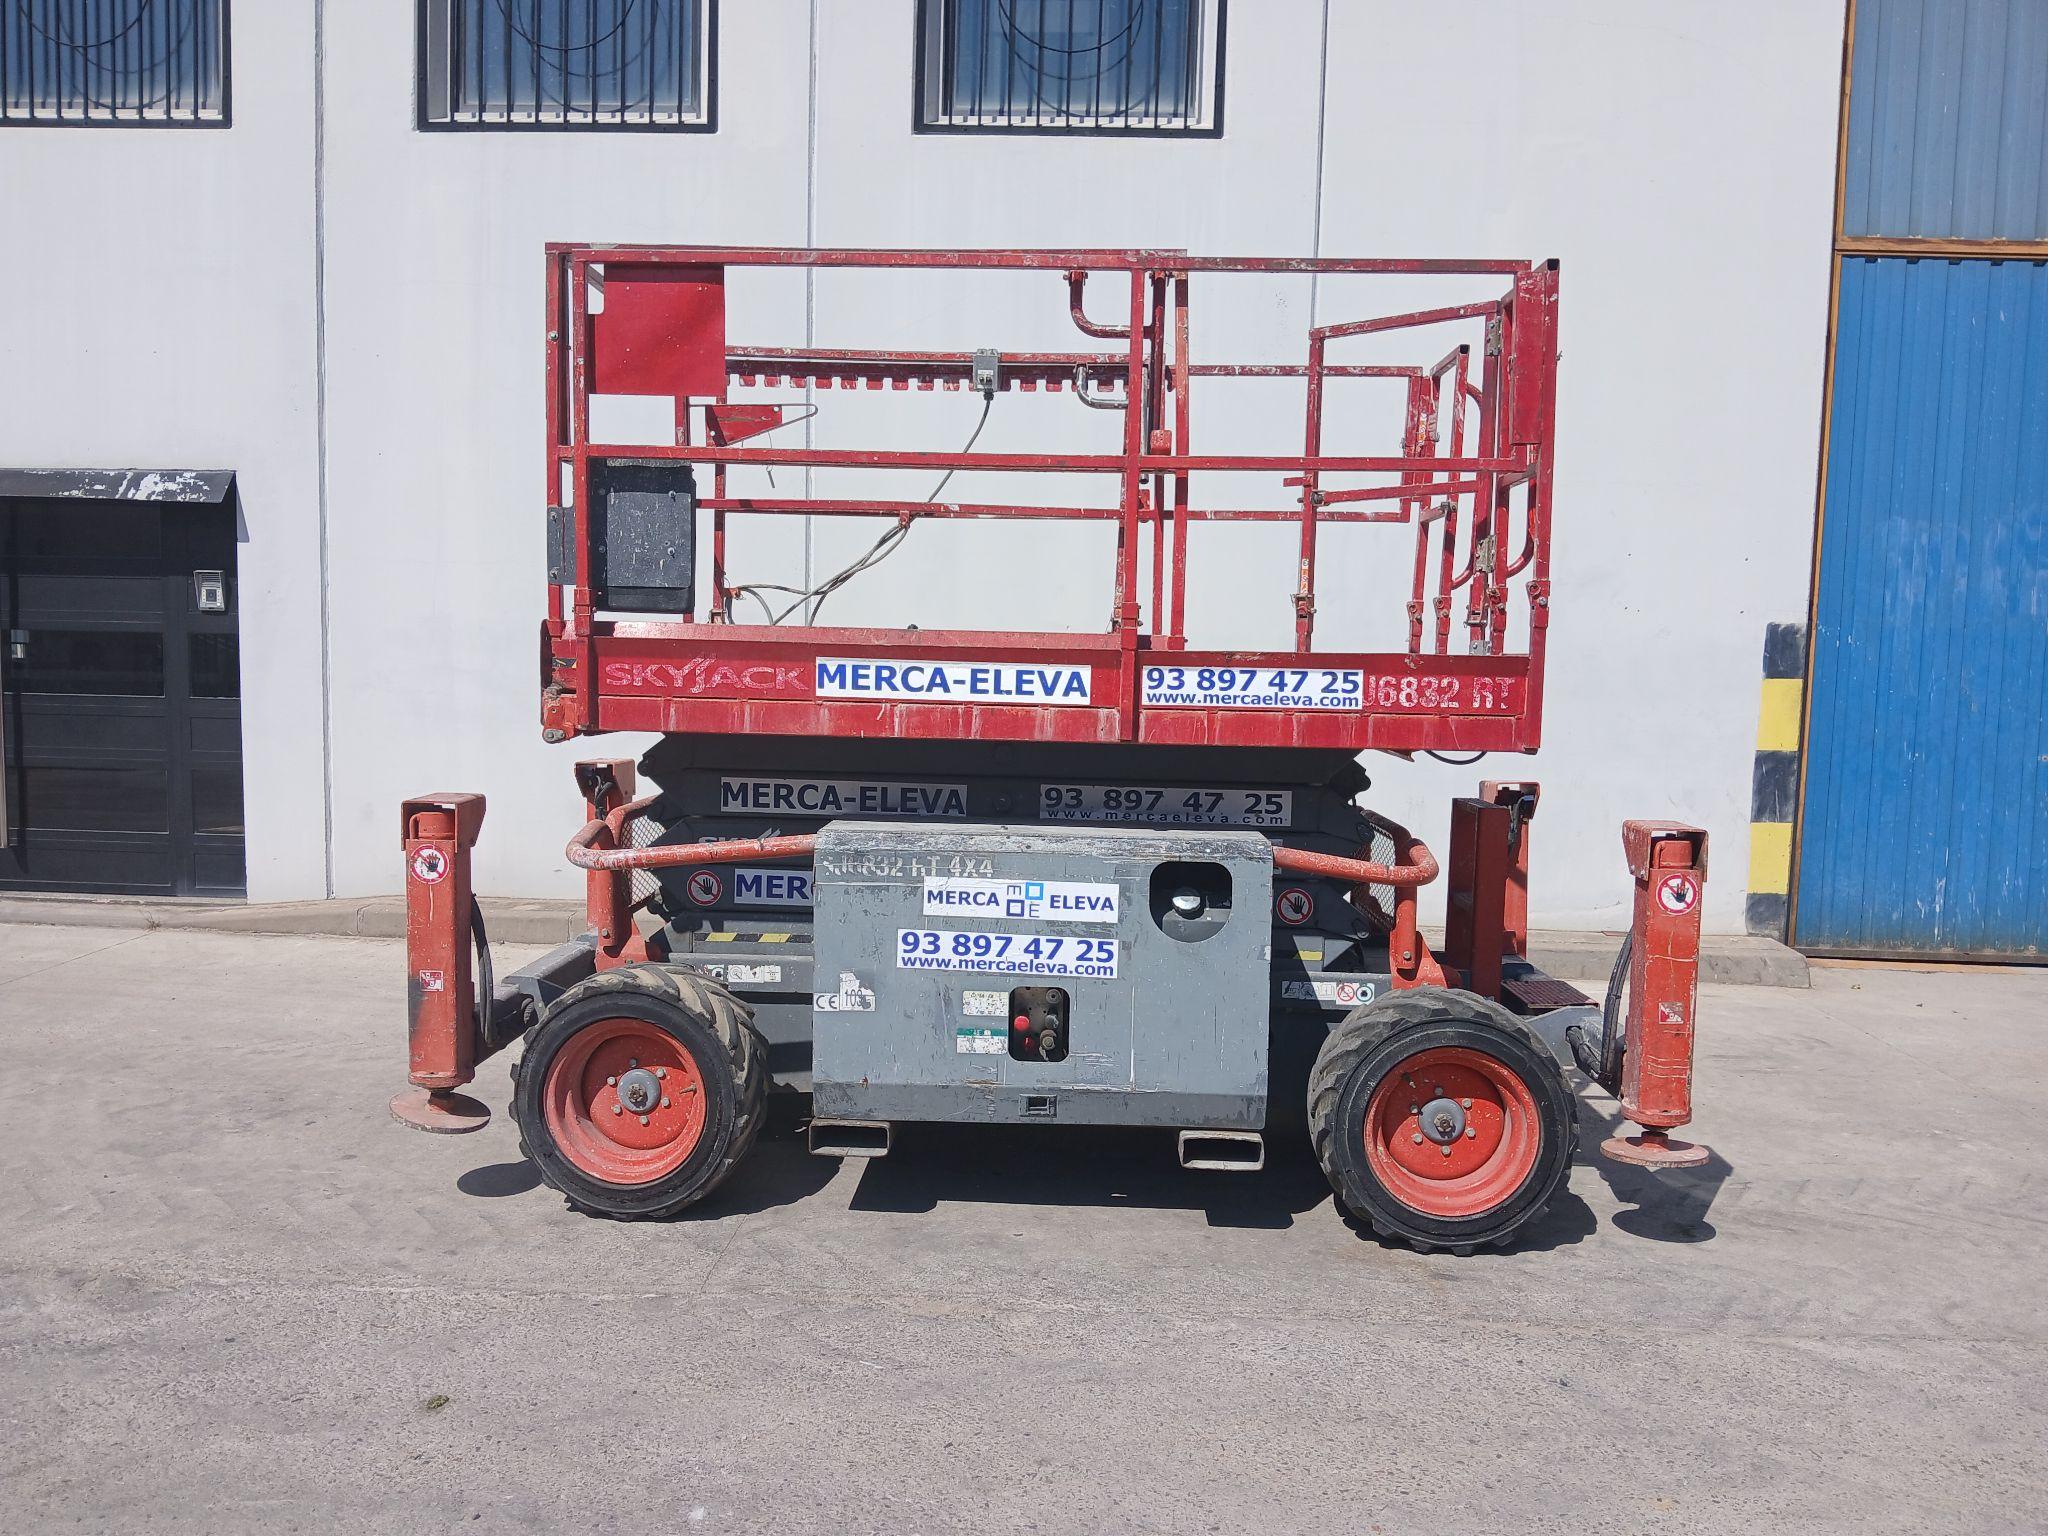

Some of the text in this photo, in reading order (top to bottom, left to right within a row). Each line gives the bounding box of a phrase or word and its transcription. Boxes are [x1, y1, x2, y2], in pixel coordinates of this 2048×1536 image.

[817, 663, 1088, 698] MERCA-ELEVA
[1146, 667, 1360, 694] 93 897 47 25
[1146, 692, 1359, 708] www.mercaeleva.com
[722, 781, 966, 815] MERCA-ELEVA
[1043, 787, 1284, 815] 93 897 47 25
[1047, 809, 1284, 825] www.mercaeleva.com
[736, 873, 814, 899] MER
[927, 889, 1114, 912] MERCA ELEVA
[901, 931, 1114, 963] 93 897 47 25
[901, 956, 1114, 976] www.mercaeleva.com
